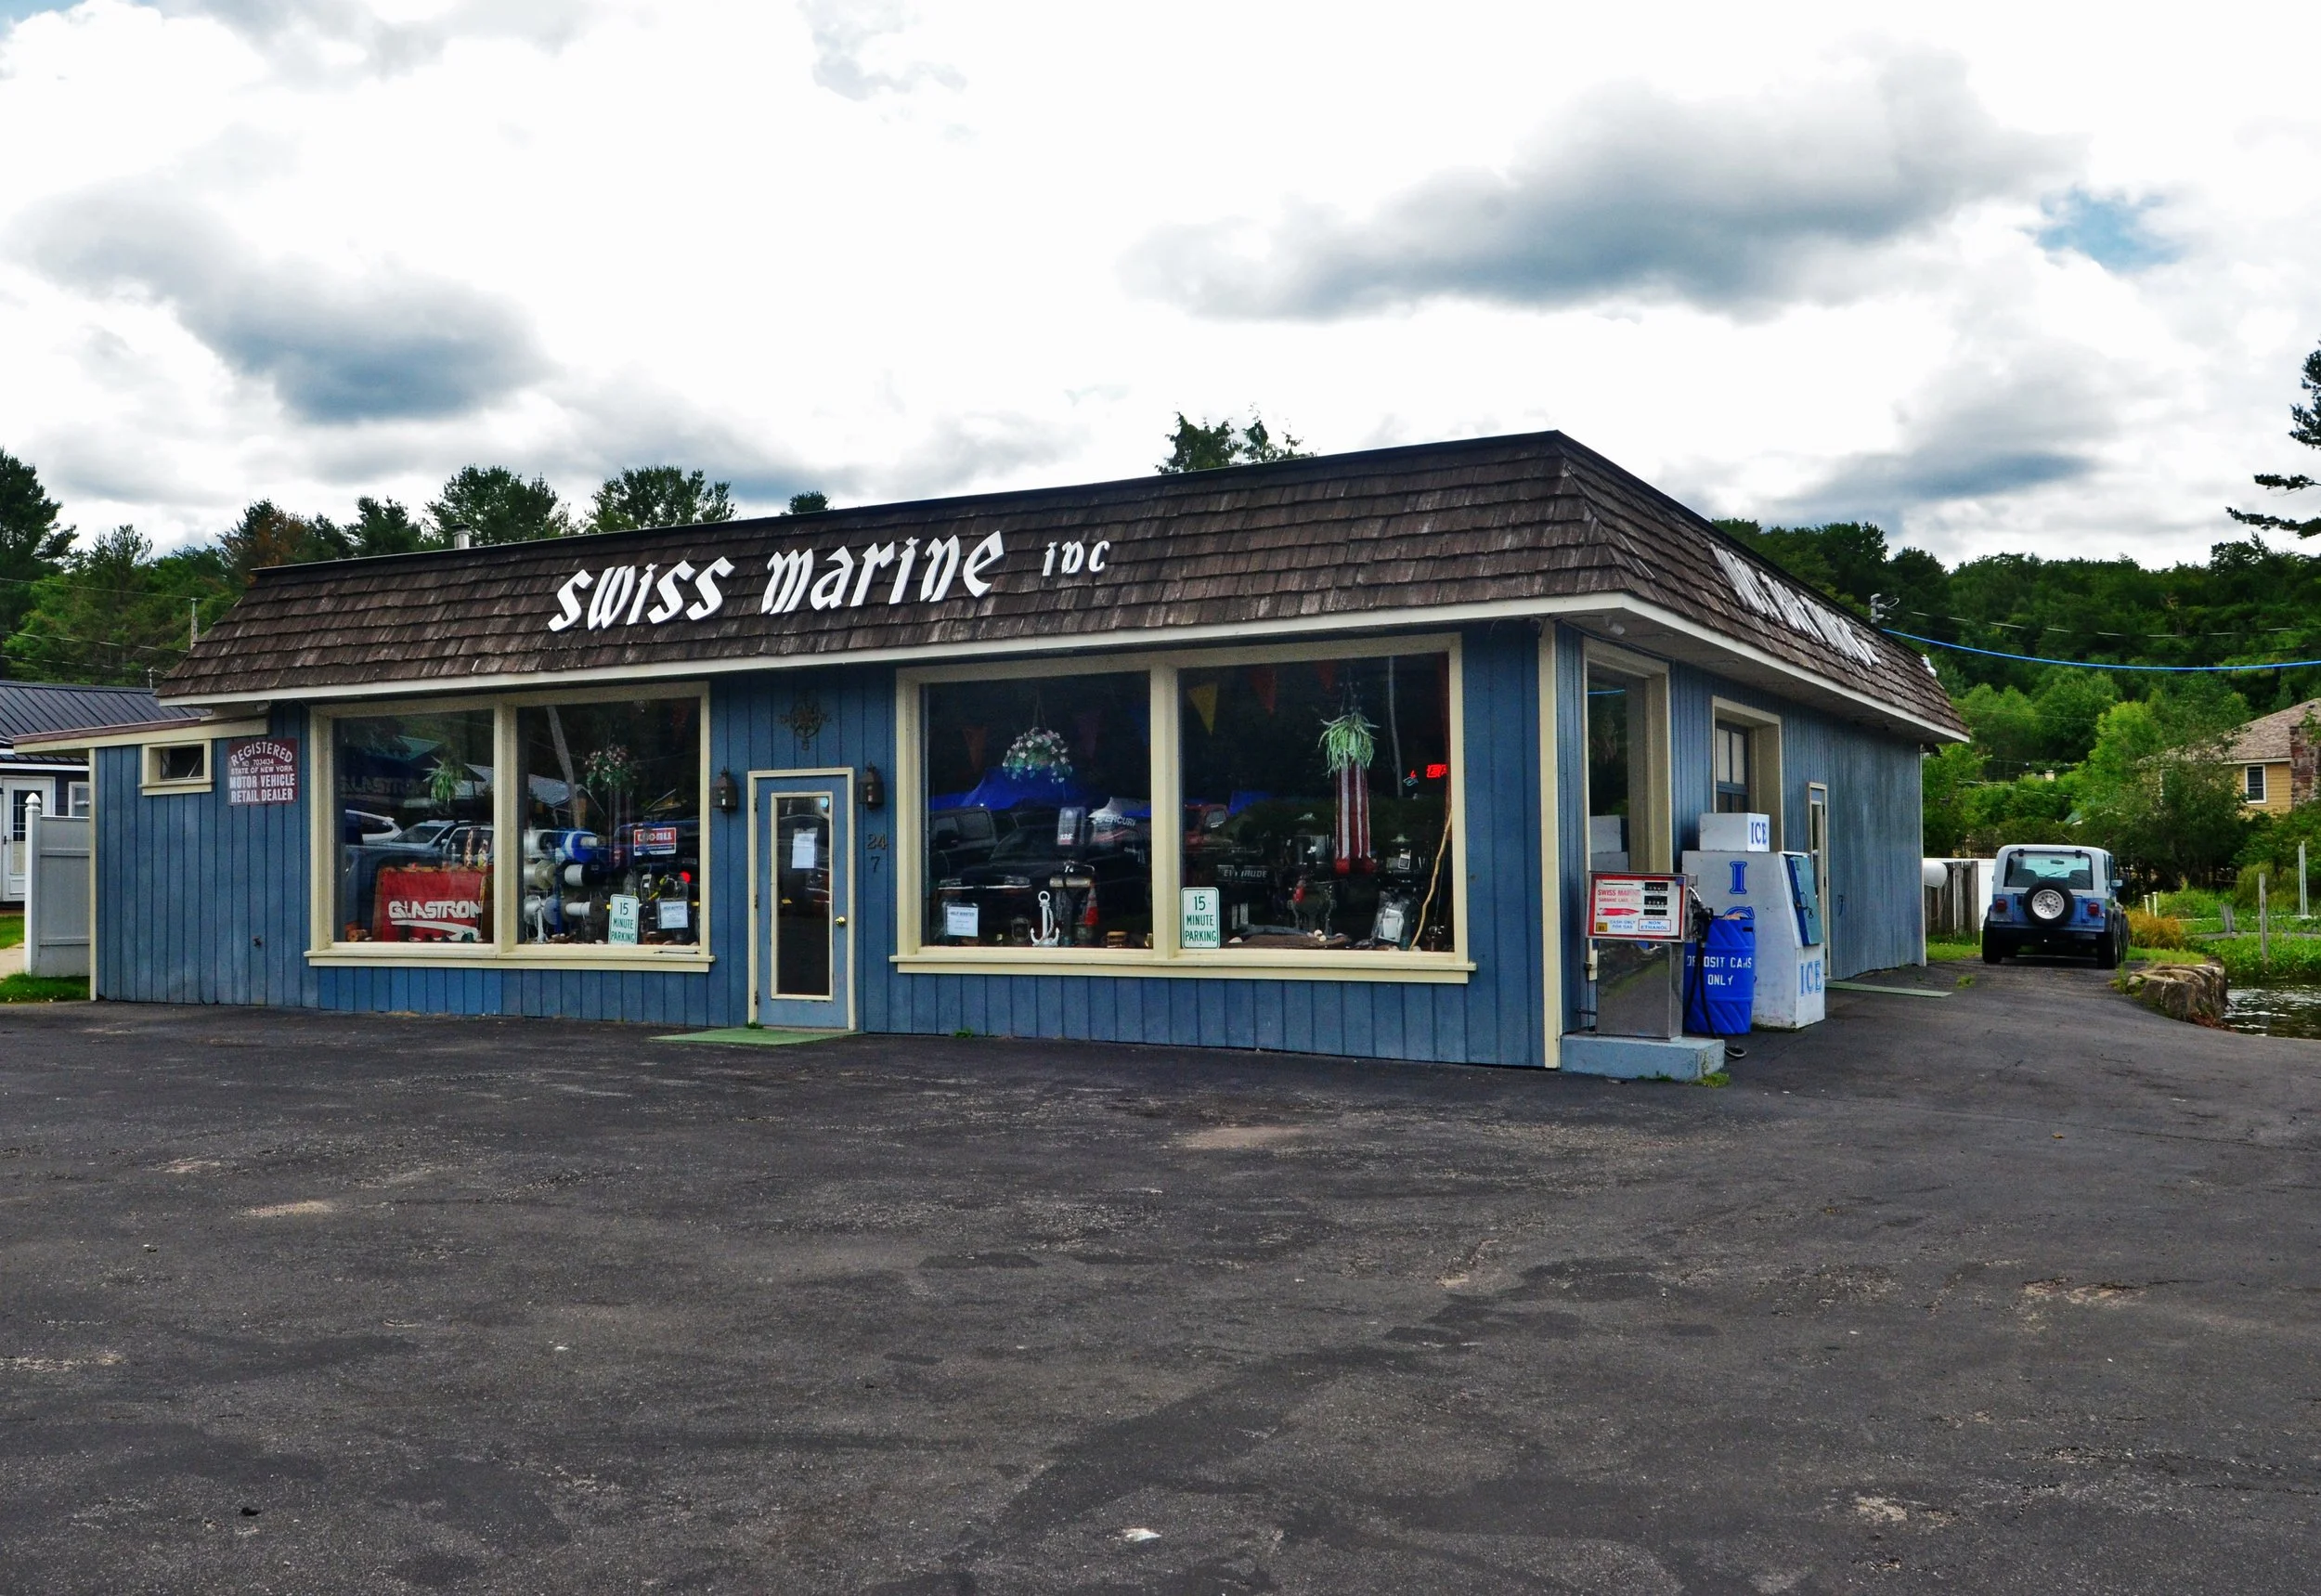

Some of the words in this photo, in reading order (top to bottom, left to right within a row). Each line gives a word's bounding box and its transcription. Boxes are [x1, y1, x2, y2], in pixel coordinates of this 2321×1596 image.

[230, 741, 293, 767] REGISTERED
[230, 767, 249, 775] STATE
[229, 775, 258, 789] MOTOR
[260, 773, 295, 787] VEHICLE
[231, 789, 260, 803] RETAIL
[261, 787, 293, 801] DEALER
[1750, 822, 1768, 845] ICE
[866, 834, 888, 850] 24
[870, 856, 881, 873] 7
[388, 900, 482, 918] GLASTRON
[619, 902, 629, 915] 15
[1194, 895, 1206, 911] 15
[614, 917, 634, 929] MINUTE
[1186, 915, 1214, 927] MINUTE
[611, 930, 635, 943] PARKING
[1185, 930, 1217, 942] PARKING
[1687, 955, 1726, 968] DEOSIT
[1707, 974, 1733, 986] ONLY
[1799, 960, 1822, 997] ICE
